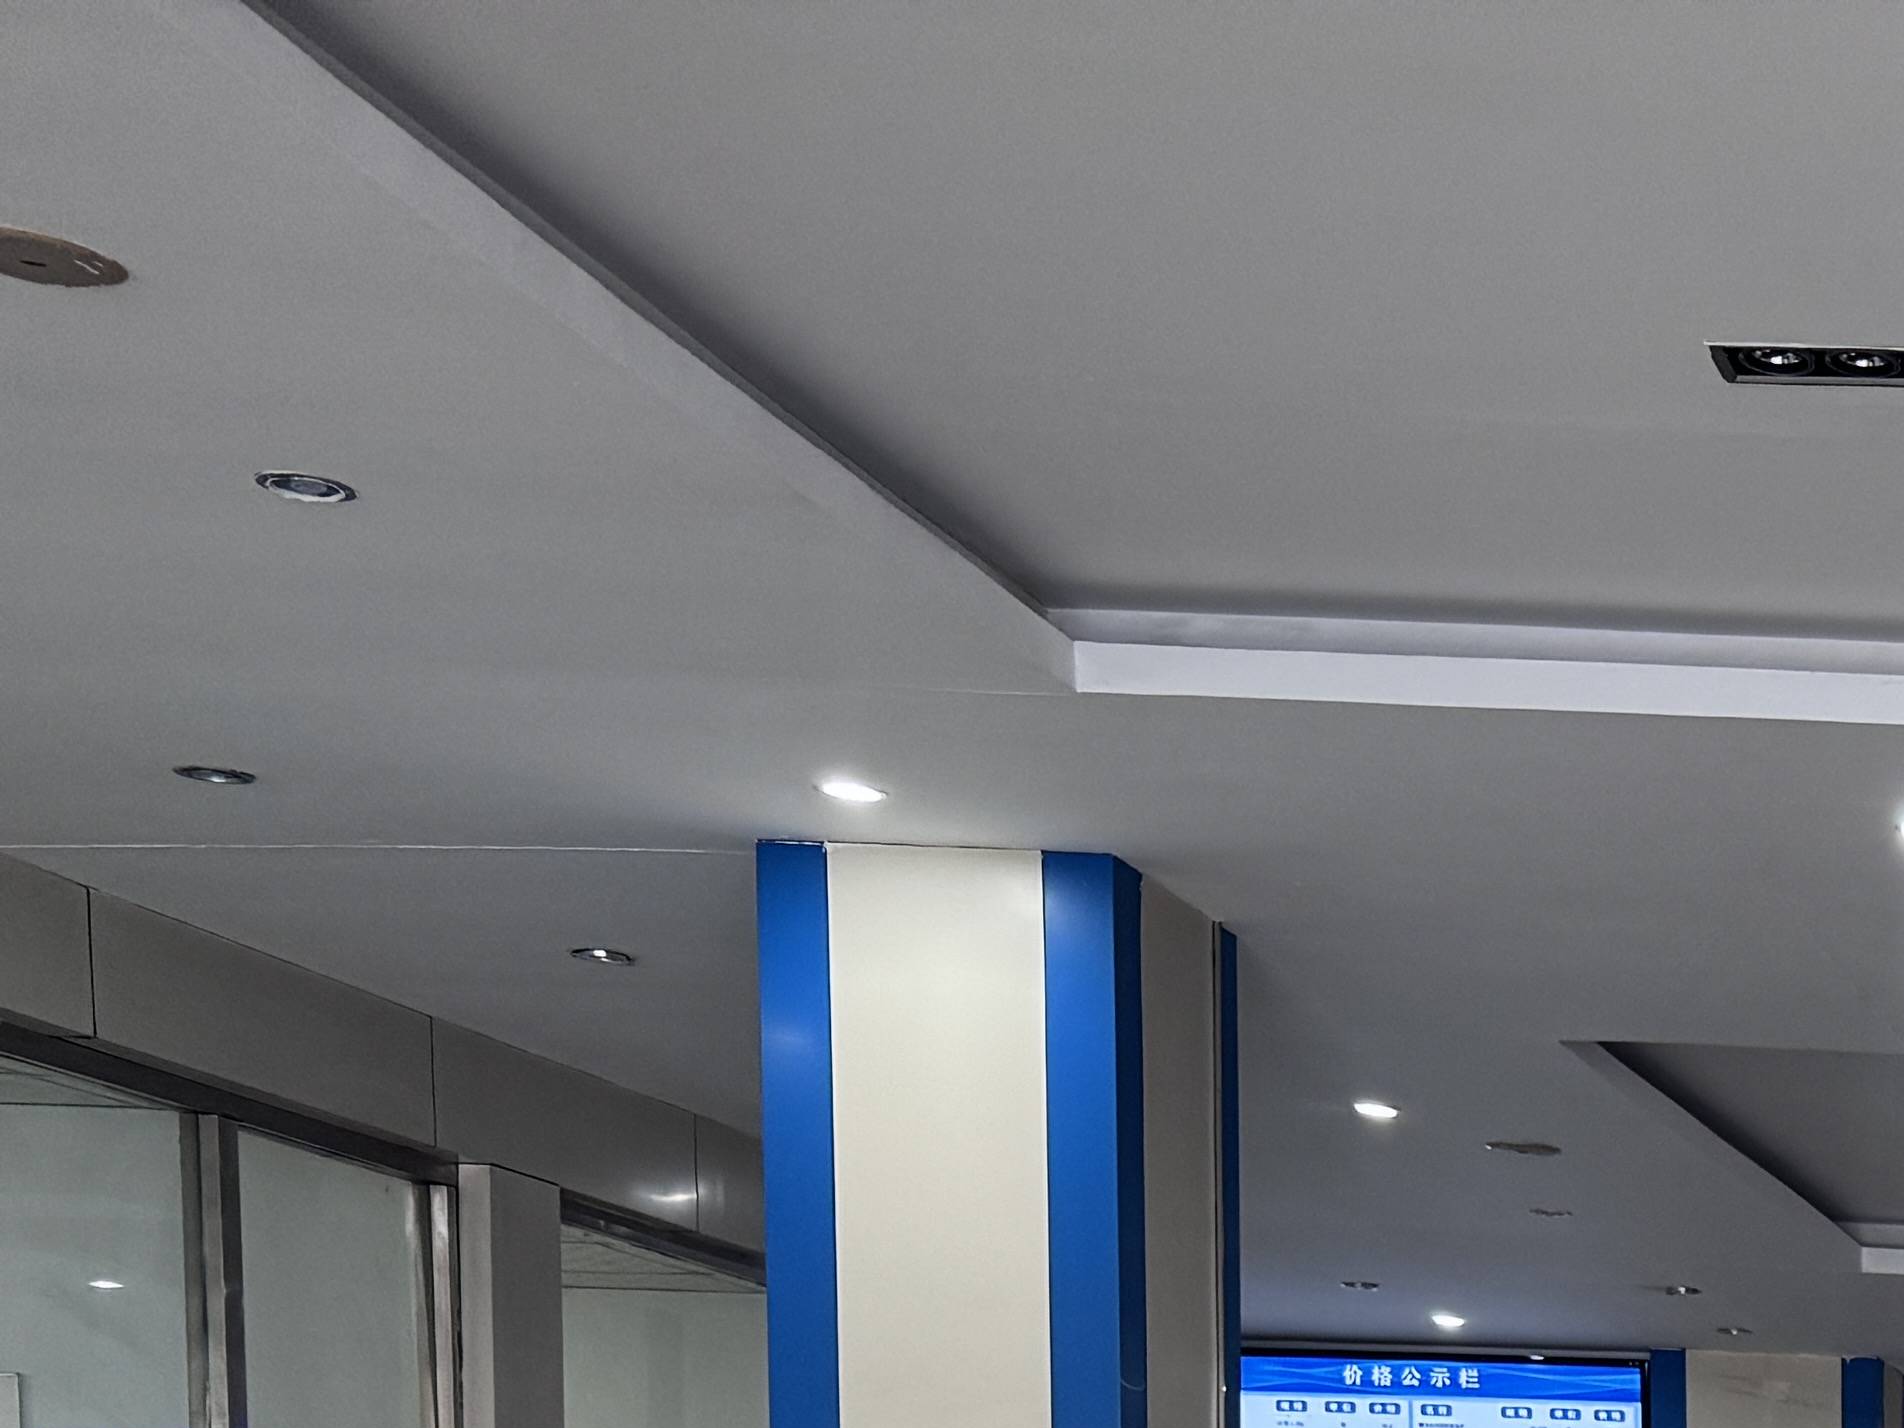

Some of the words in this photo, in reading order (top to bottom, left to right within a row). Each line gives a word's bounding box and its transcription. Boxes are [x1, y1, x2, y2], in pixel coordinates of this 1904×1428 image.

[1343, 1364, 1480, 1389] 价格公示栏
